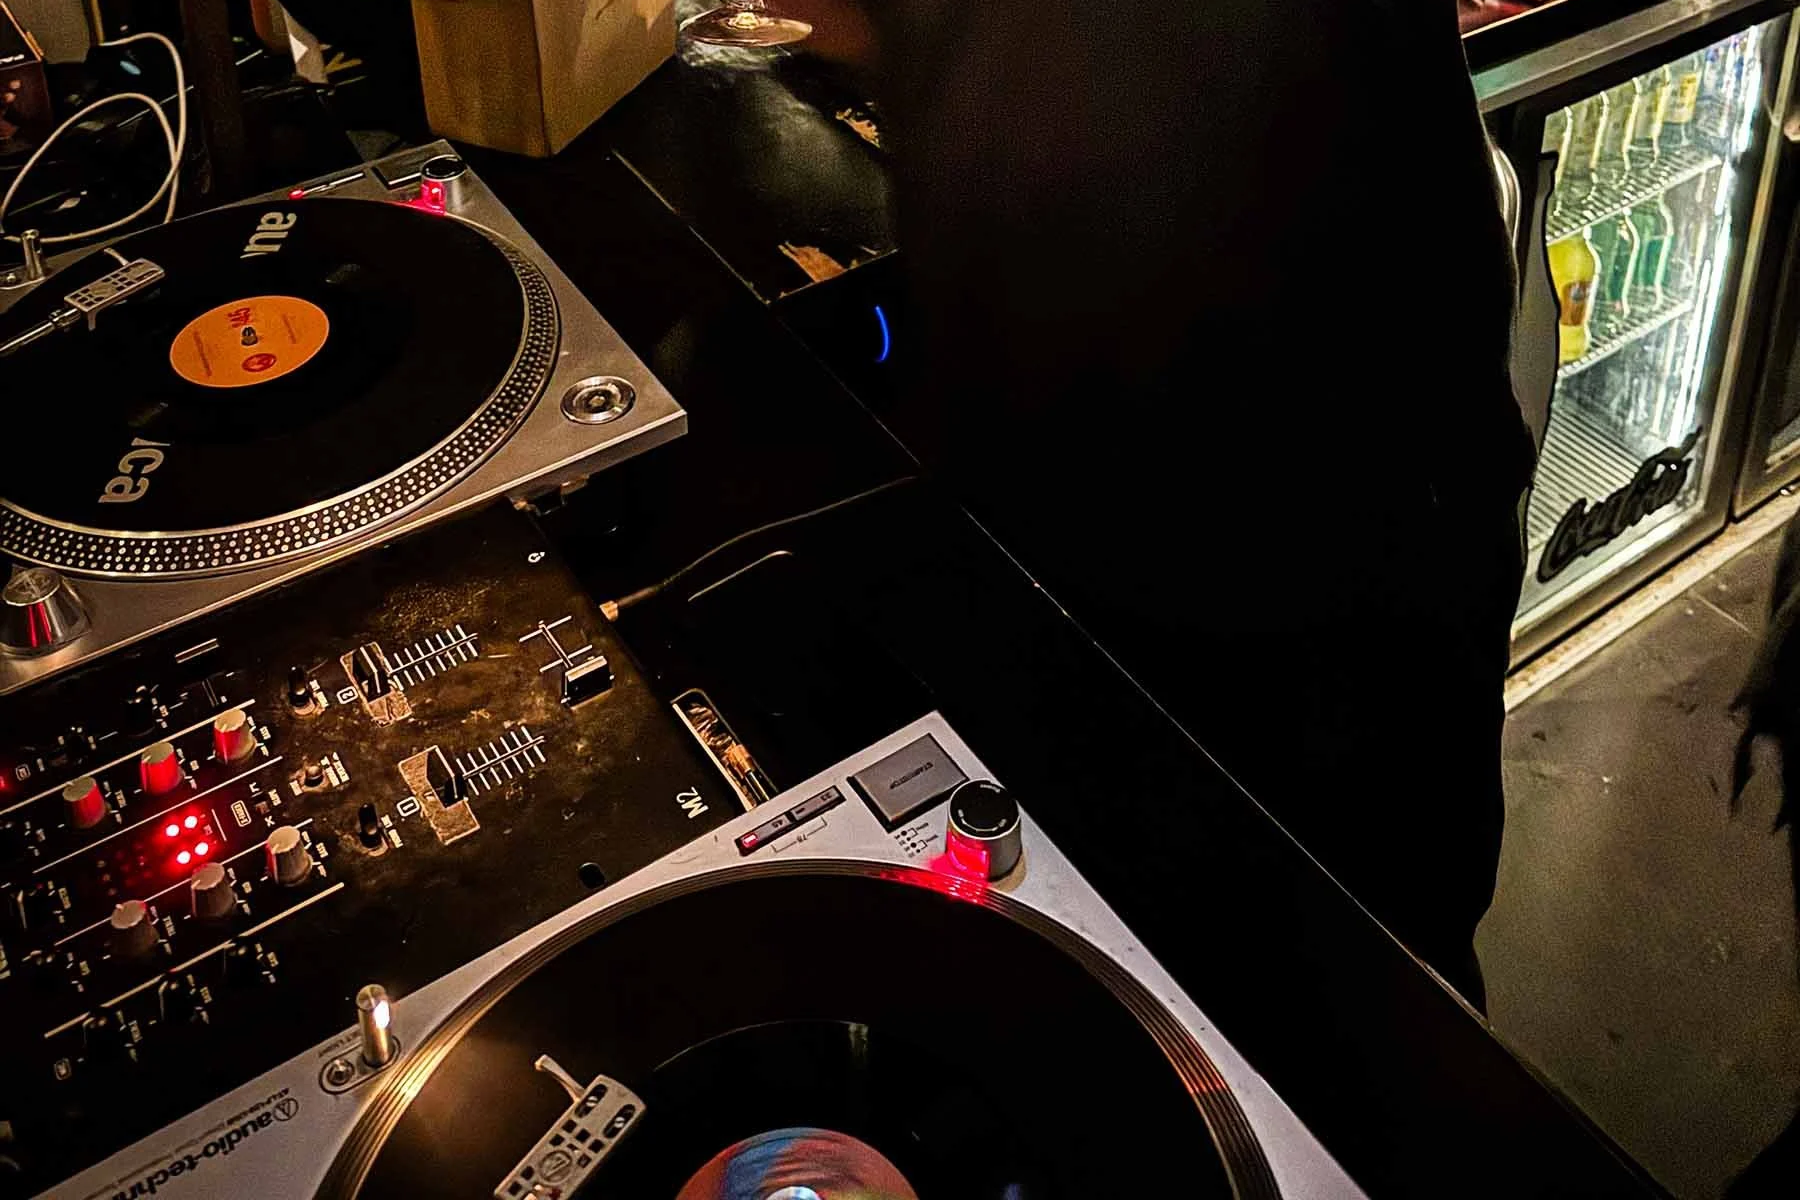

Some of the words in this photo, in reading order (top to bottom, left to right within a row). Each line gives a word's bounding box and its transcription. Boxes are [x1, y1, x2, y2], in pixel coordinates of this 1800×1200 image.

[240, 211, 297, 259] au
[341, 688, 354, 701] 2
[676, 785, 709, 819] M2
